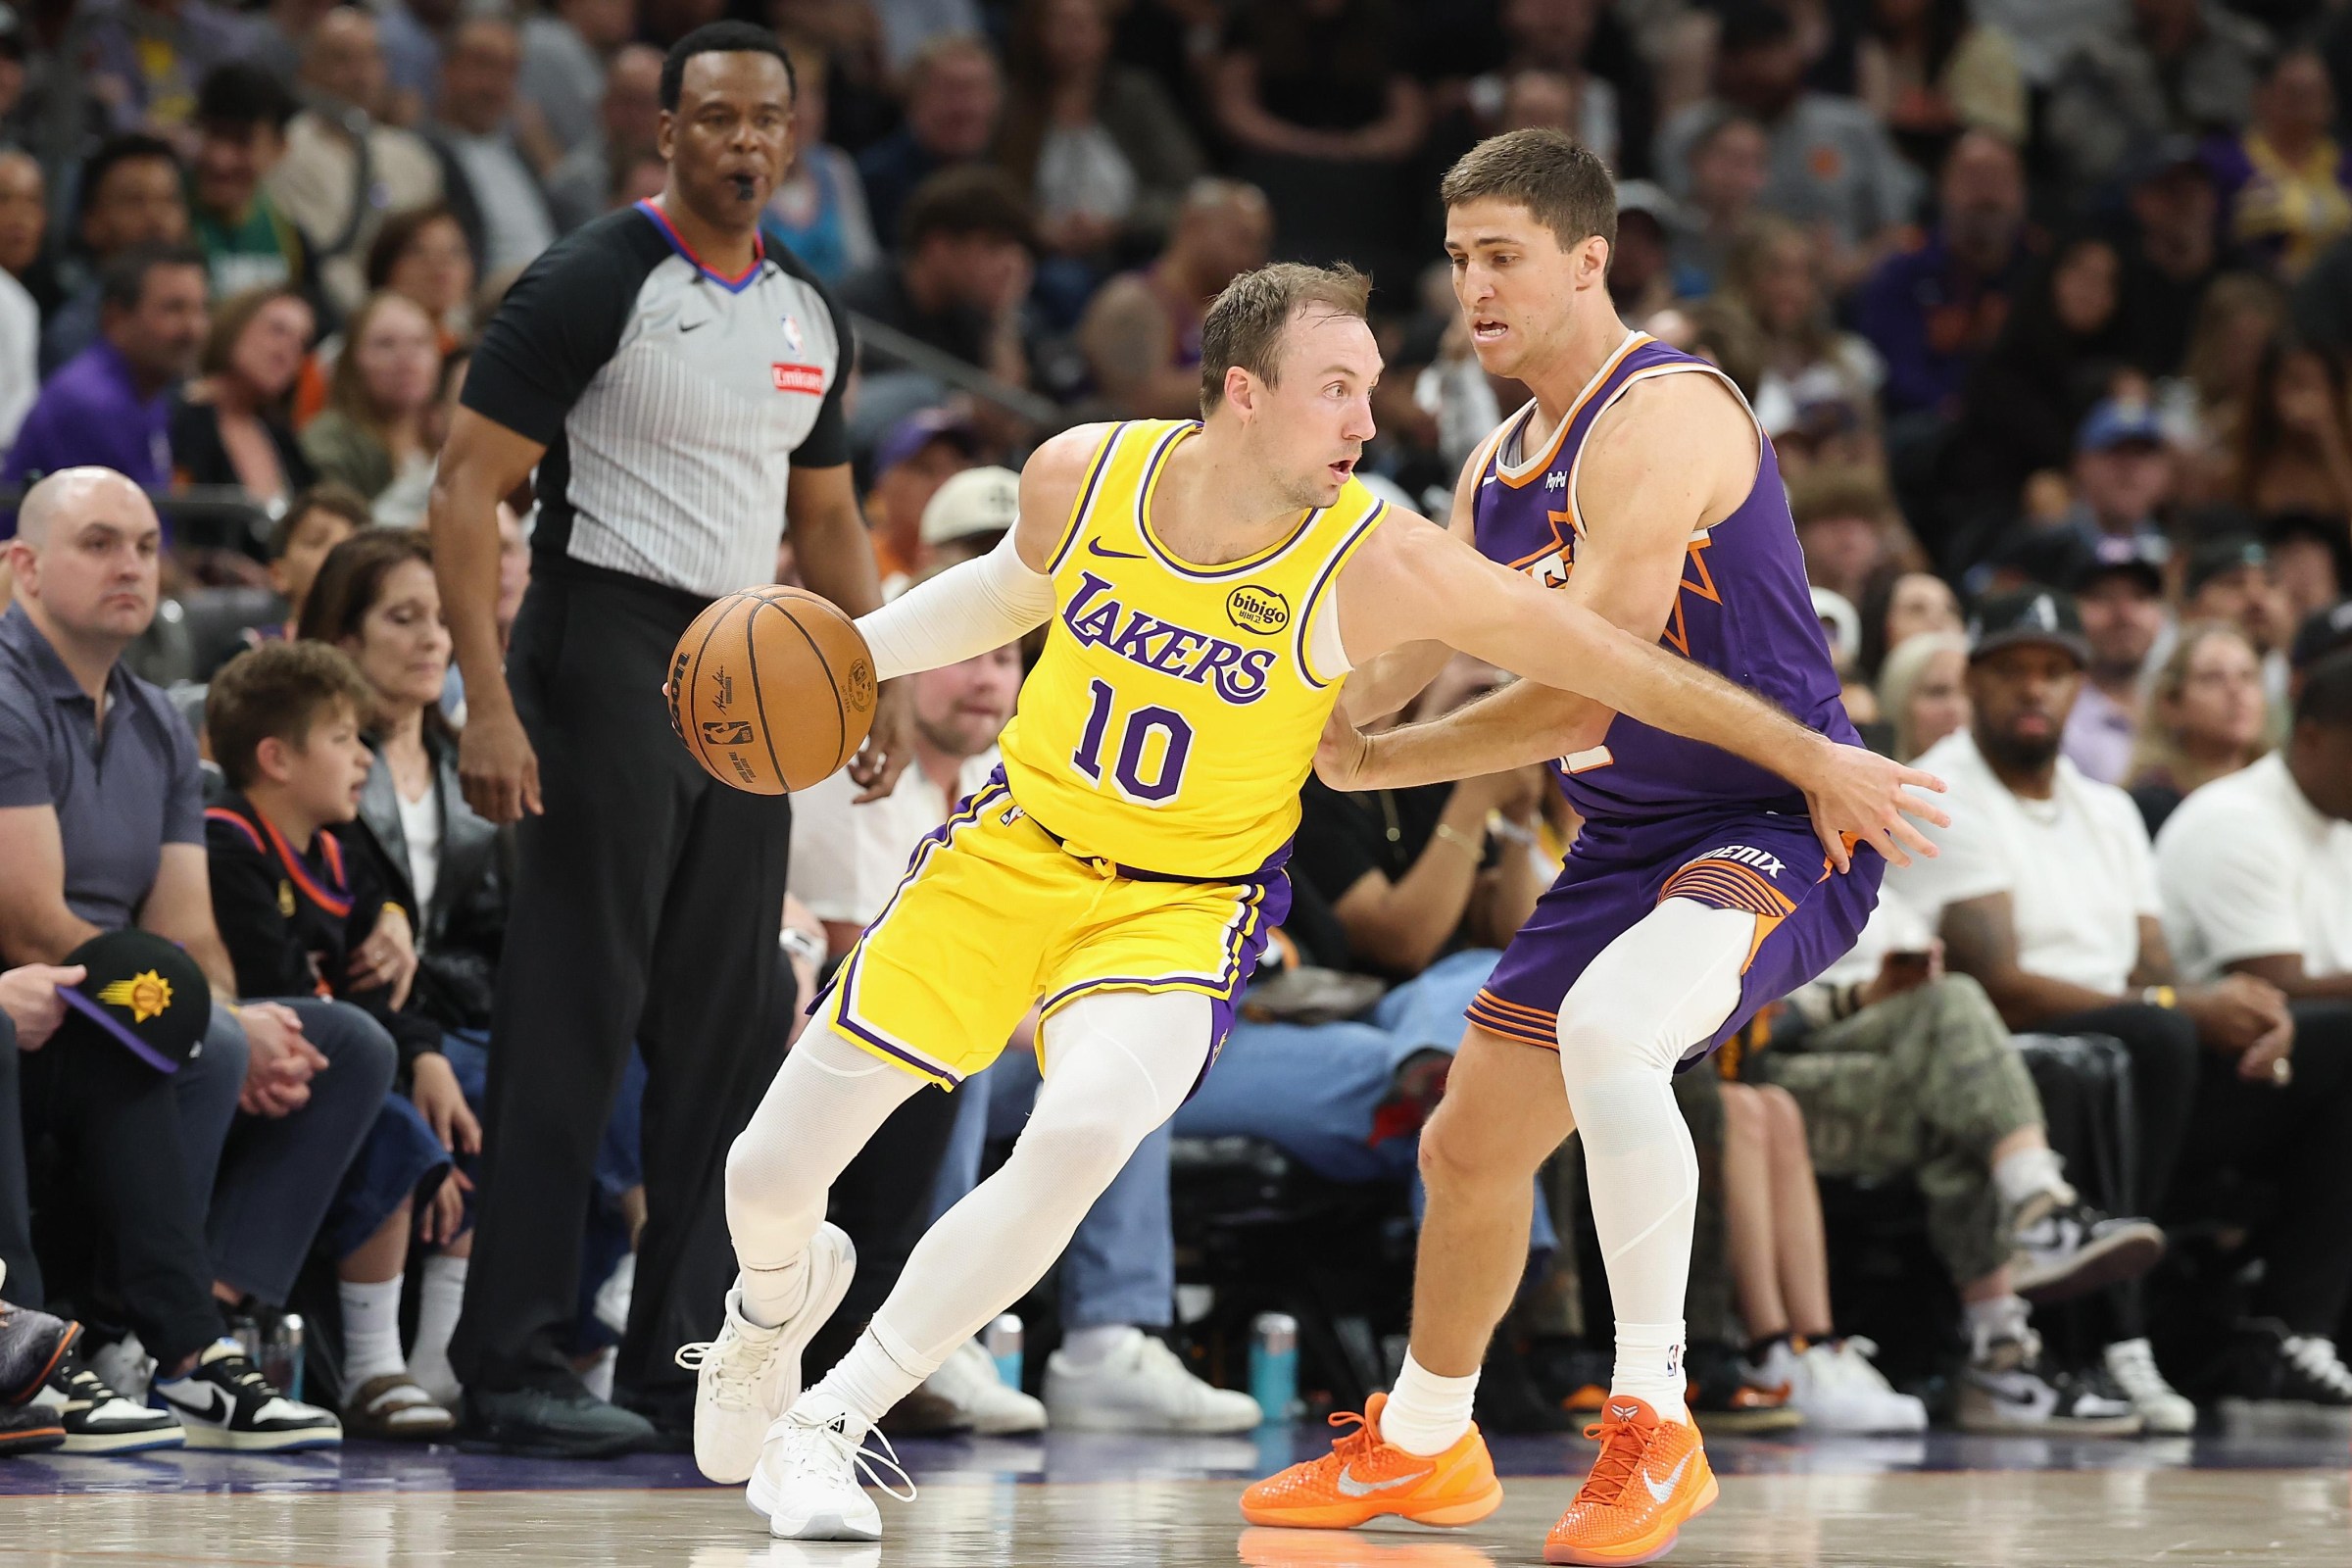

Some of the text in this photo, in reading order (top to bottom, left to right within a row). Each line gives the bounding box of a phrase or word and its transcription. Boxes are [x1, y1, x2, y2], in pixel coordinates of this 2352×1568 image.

[1060, 569, 1279, 707] LAKERS
[1233, 592, 1286, 624] bibigo
[1070, 676, 1196, 808] 10
